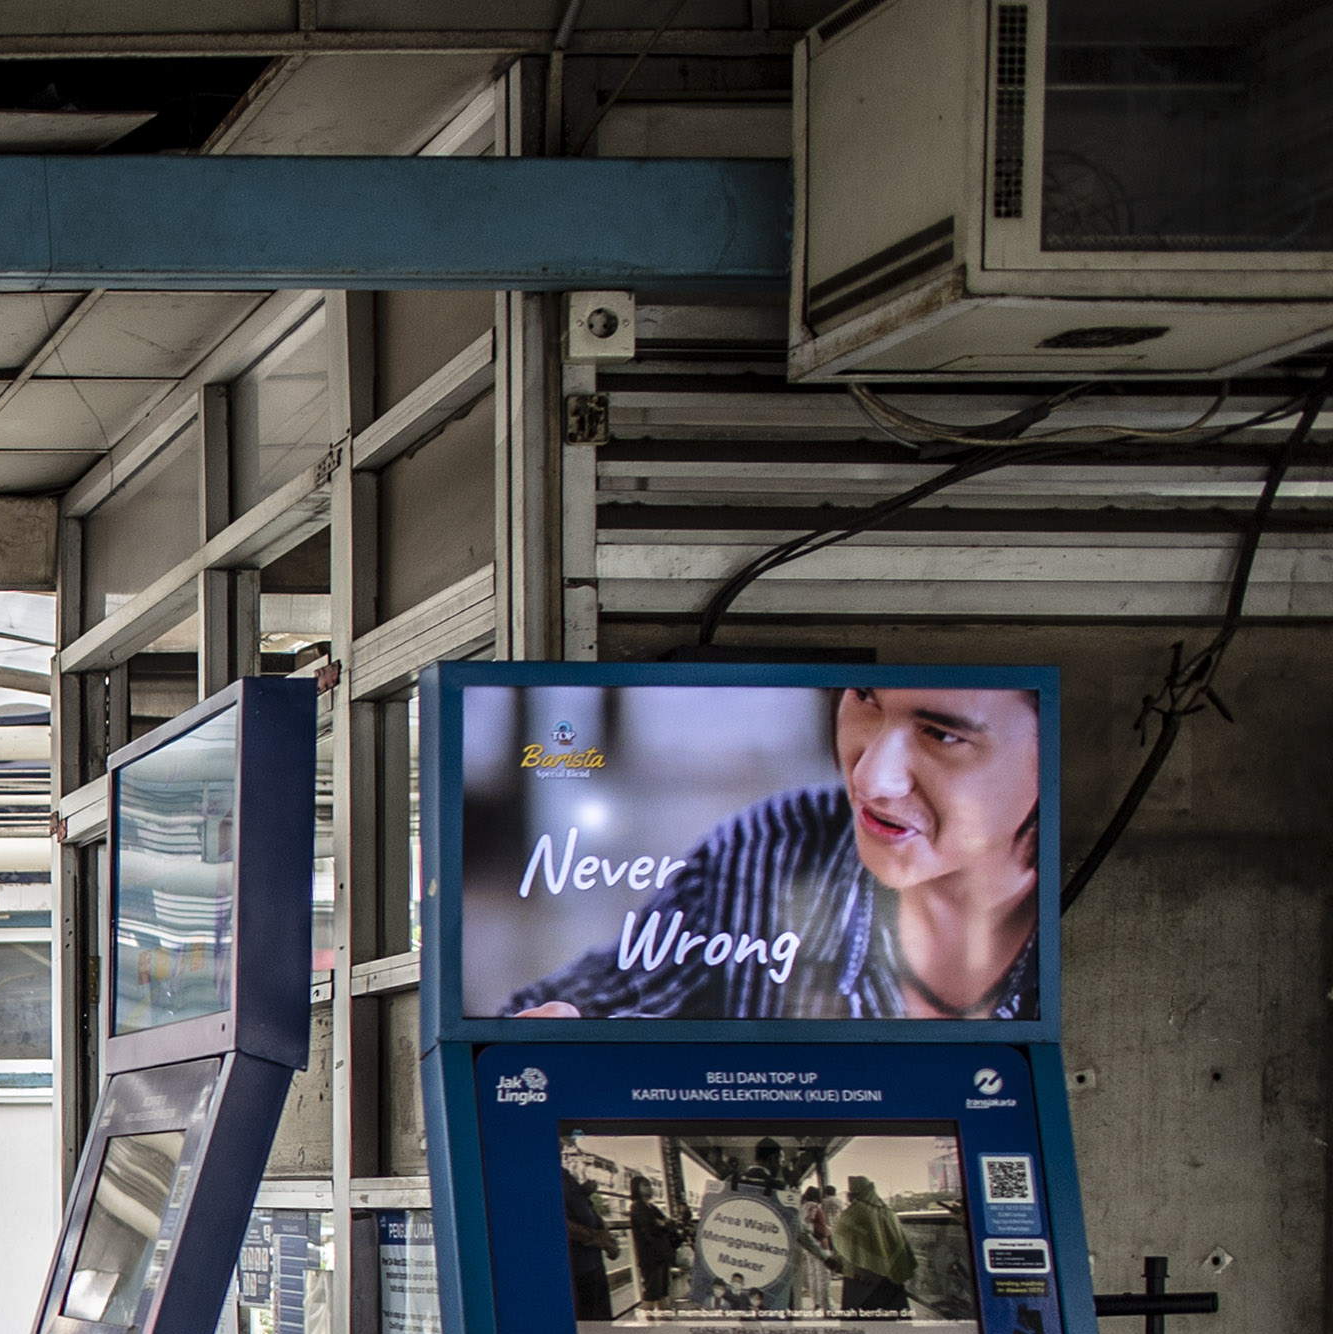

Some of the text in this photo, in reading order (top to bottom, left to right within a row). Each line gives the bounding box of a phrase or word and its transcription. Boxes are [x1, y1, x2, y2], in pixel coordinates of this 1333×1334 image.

[520, 743, 606, 769] Barista
[518, 827, 687, 898] Never
[618, 910, 800, 984] Wrong
[496, 1076, 522, 1089] Jak
[706, 1072, 818, 1084] BELI DAN TOP UP
[496, 1089, 547, 1105] Lingko
[631, 1089, 882, 1102] KARTU UANG ELEKTRONIK (KUE) DISINI
[965, 1098, 1017, 1108] transjakarta
[714, 1212, 780, 1234] Area Wajib
[702, 1230, 789, 1256] Menggunakan
[717, 1253, 765, 1272] Masker
[677, 1307, 723, 1317] membuat
[758, 1310, 786, 1319] orang
[786, 1308, 813, 1317] harus
[826, 1308, 858, 1317] rumah
[859, 1307, 899, 1317] berdiam
